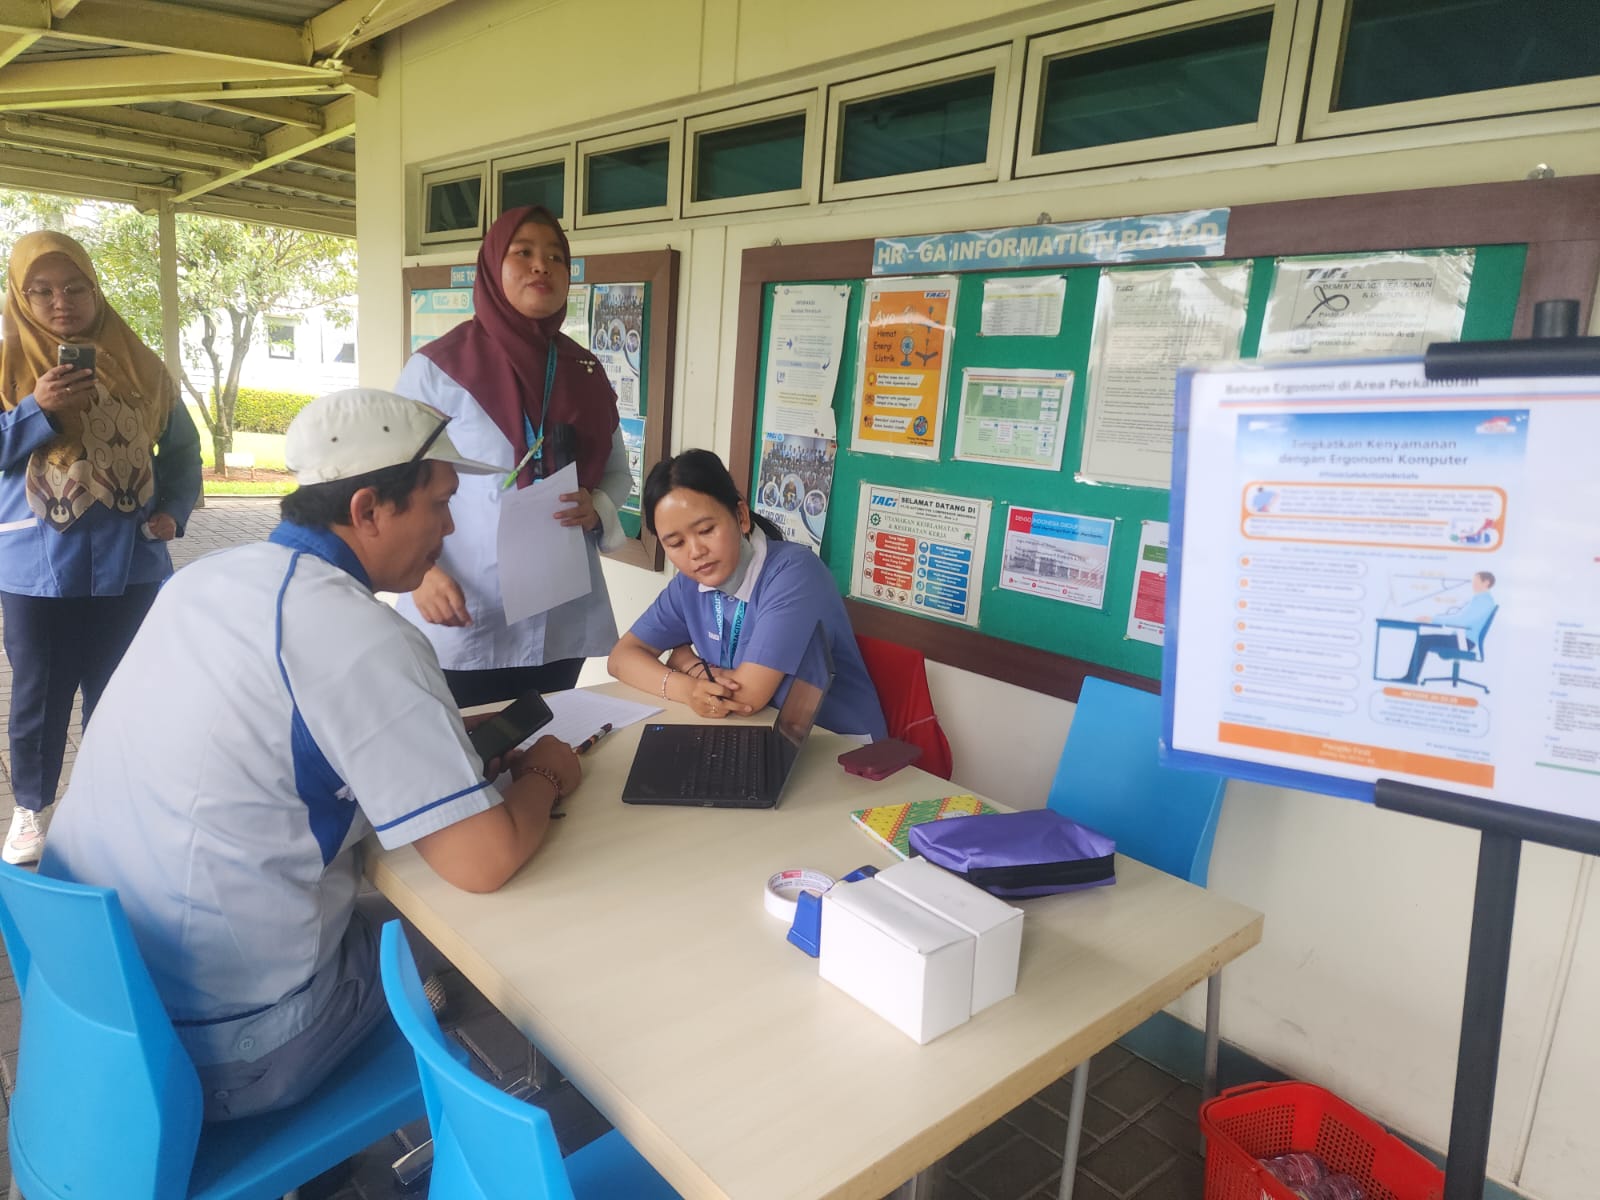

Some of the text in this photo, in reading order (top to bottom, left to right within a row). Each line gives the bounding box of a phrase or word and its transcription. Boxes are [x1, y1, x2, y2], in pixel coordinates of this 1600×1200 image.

[919, 243, 947, 263] GA
[951, 230, 1118, 262] INFORMATION
[1120, 222, 1219, 250] BOARD
[1353, 379, 1386, 391] Area
[1367, 439, 1457, 451] Kenyamanan
[1279, 454, 1468, 466] dengan Ergonomi Komputer
[901, 496, 933, 507] SELAMAT
[935, 501, 966, 512] DATANG
[967, 506, 976, 514] DI
